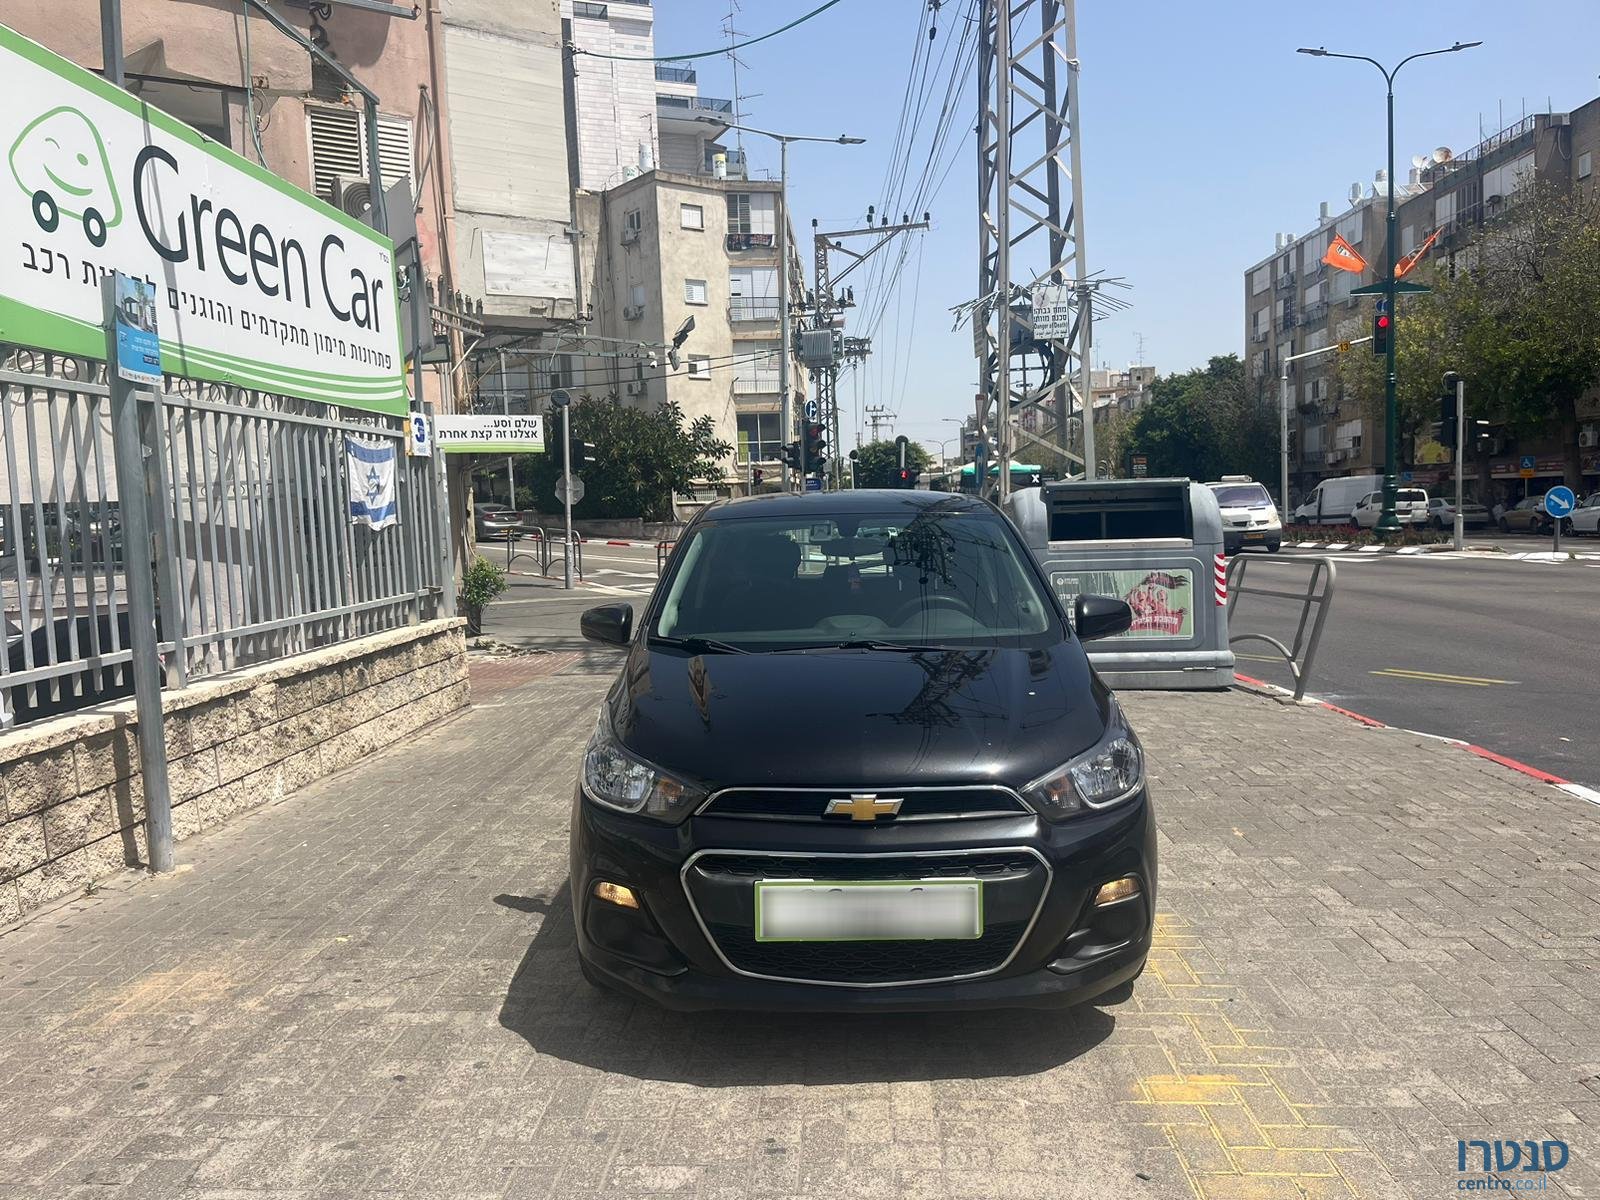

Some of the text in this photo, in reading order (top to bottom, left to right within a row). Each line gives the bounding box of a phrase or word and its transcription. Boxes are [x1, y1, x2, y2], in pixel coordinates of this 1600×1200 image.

[133, 145, 383, 332] Green Car
[22, 242, 70, 279] רכב
[168, 288, 233, 325] והוגנים
[241, 310, 309, 346] מתקדמים
[314, 332, 346, 357] מימון
[350, 343, 392, 370] פתרונות
[1340, 343, 1349, 351] 13
[439, 429, 537, 440] אצלנו זה קצת אחרת
[484, 418, 537, 428] שלם וסע...
